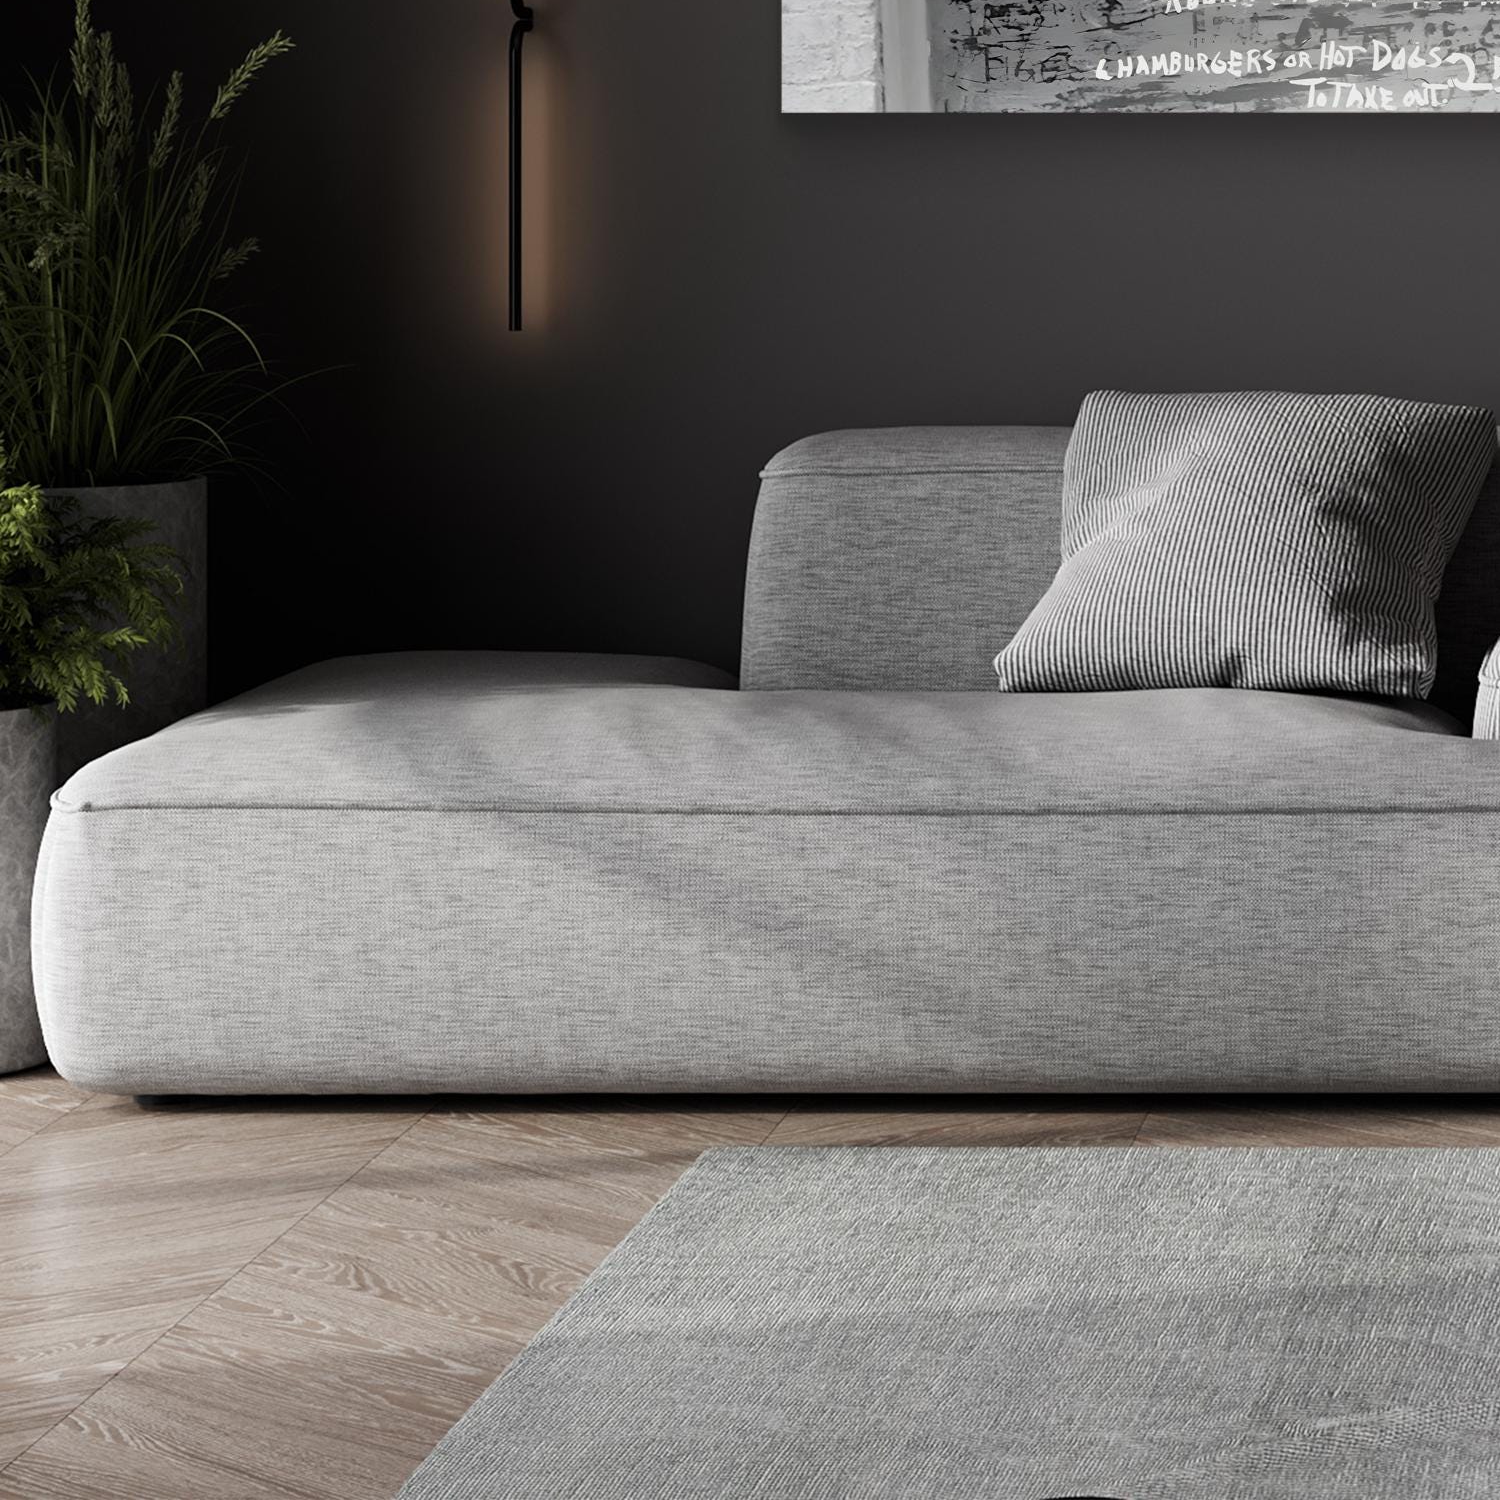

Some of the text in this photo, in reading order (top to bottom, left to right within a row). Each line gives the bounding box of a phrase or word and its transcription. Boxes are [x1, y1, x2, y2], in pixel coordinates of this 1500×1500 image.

[1116, 48, 1276, 78] HAMBURGERS
[1319, 40, 1367, 71] HOT
[1372, 38, 1443, 72] DOGS
[1326, 81, 1399, 111] TAKE
